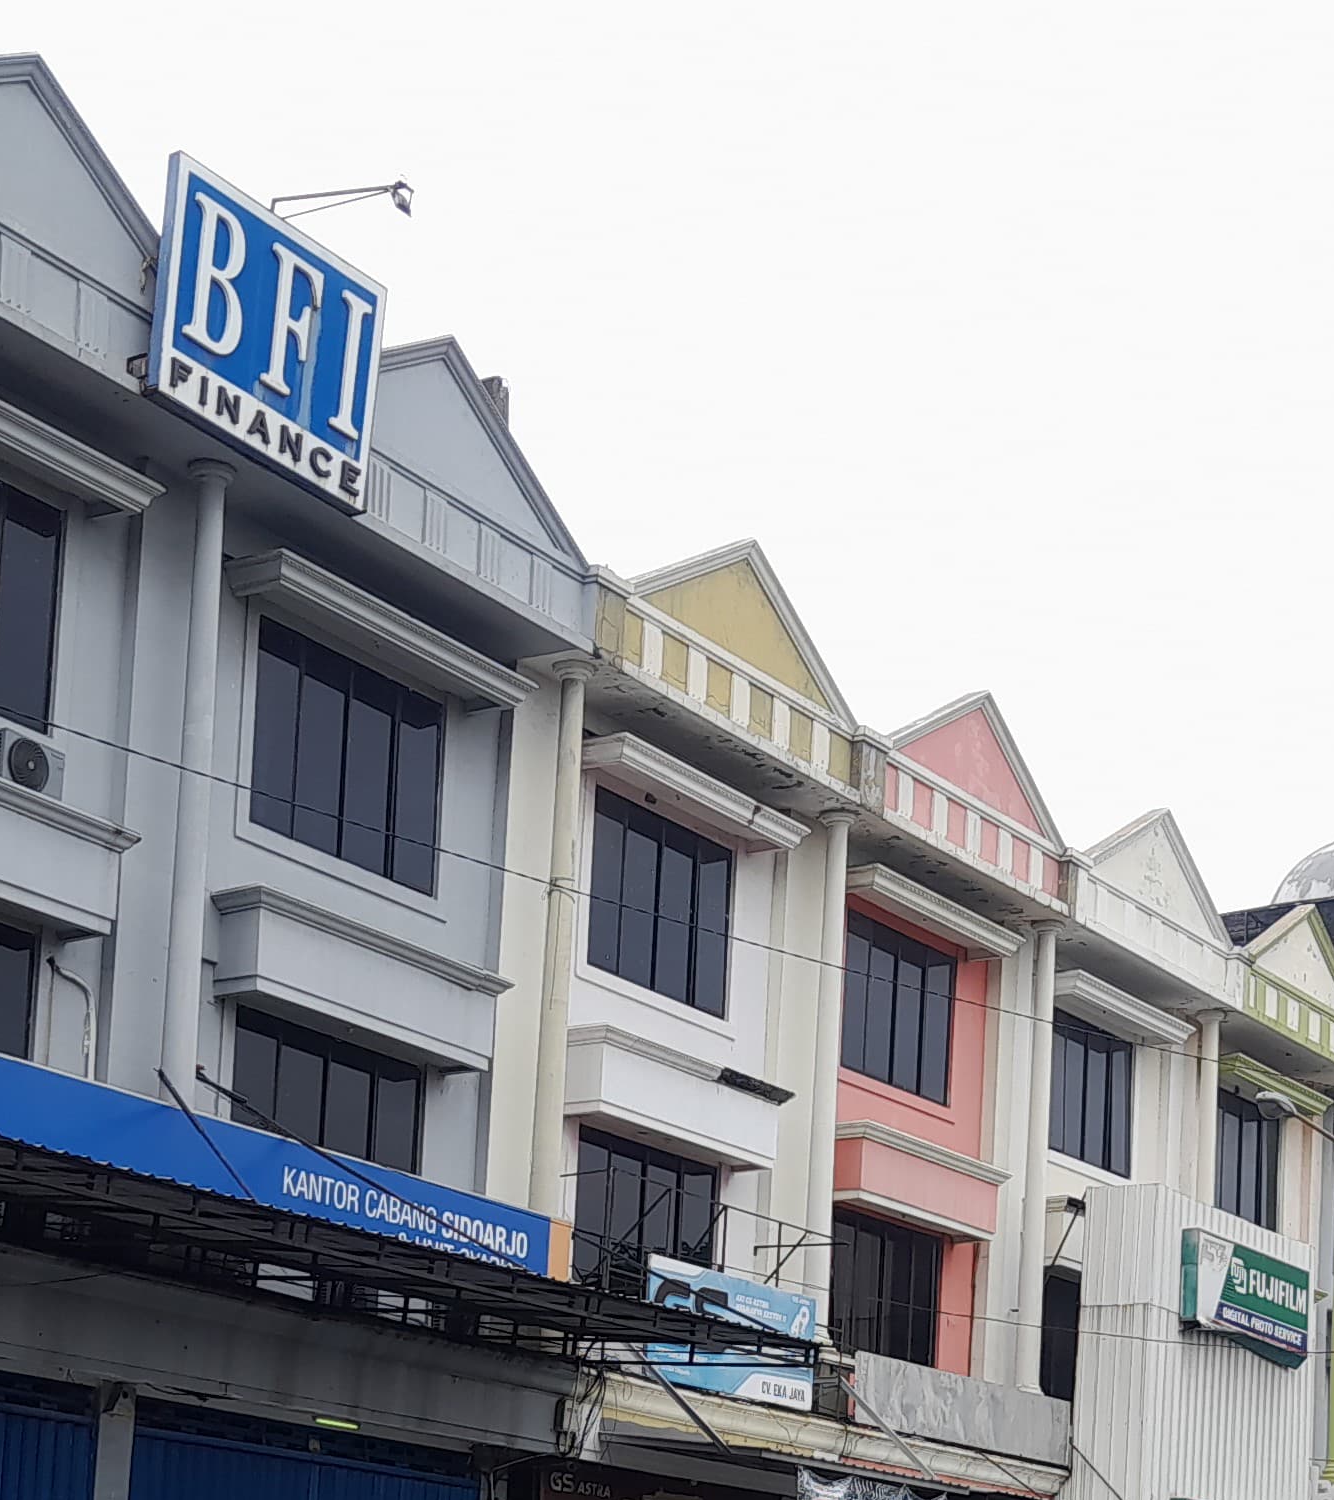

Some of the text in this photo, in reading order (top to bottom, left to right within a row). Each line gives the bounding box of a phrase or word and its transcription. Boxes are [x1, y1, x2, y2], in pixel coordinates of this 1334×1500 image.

[181, 192, 373, 440] BFI
[170, 356, 361, 497] FINANCE
[282, 1165, 359, 1213] KANTOR
[365, 1190, 437, 1234] CABANG
[441, 1211, 528, 1258] SIDOARJO
[1223, 1306, 1302, 1346] DIGITAL PHOTO SERVICE
[1249, 1268, 1307, 1315] FUJIFILM
[549, 1471, 611, 1498] GS ASTRA
